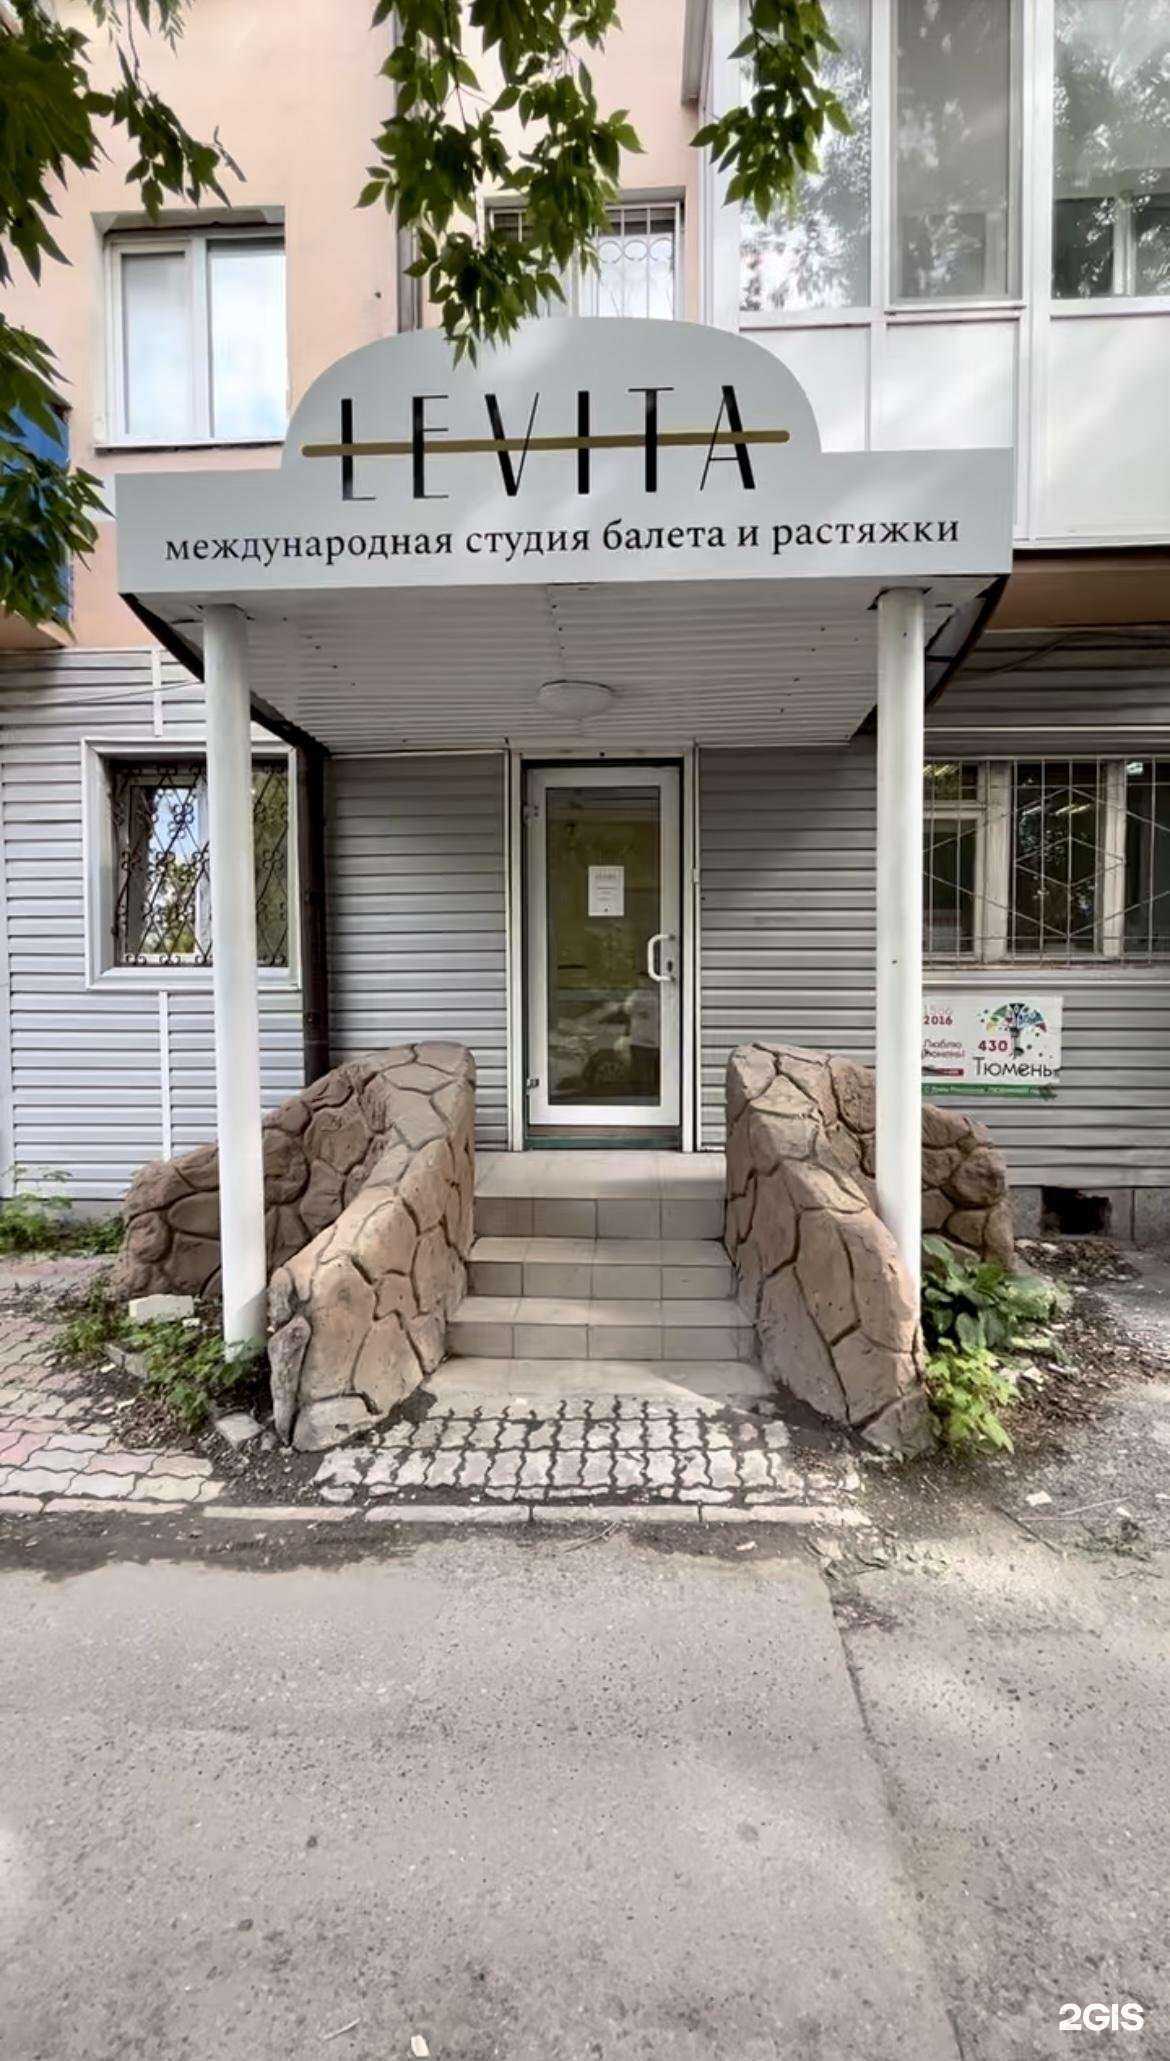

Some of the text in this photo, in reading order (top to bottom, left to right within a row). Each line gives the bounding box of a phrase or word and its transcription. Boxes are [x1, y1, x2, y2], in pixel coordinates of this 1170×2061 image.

[340, 385, 757, 501] LEVITA
[165, 518, 960, 567] международная студия балета и растяжки
[923, 1015, 953, 1026] 2016
[977, 1040, 1008, 1052] 430
[972, 1056, 1053, 1077] Тюмень
